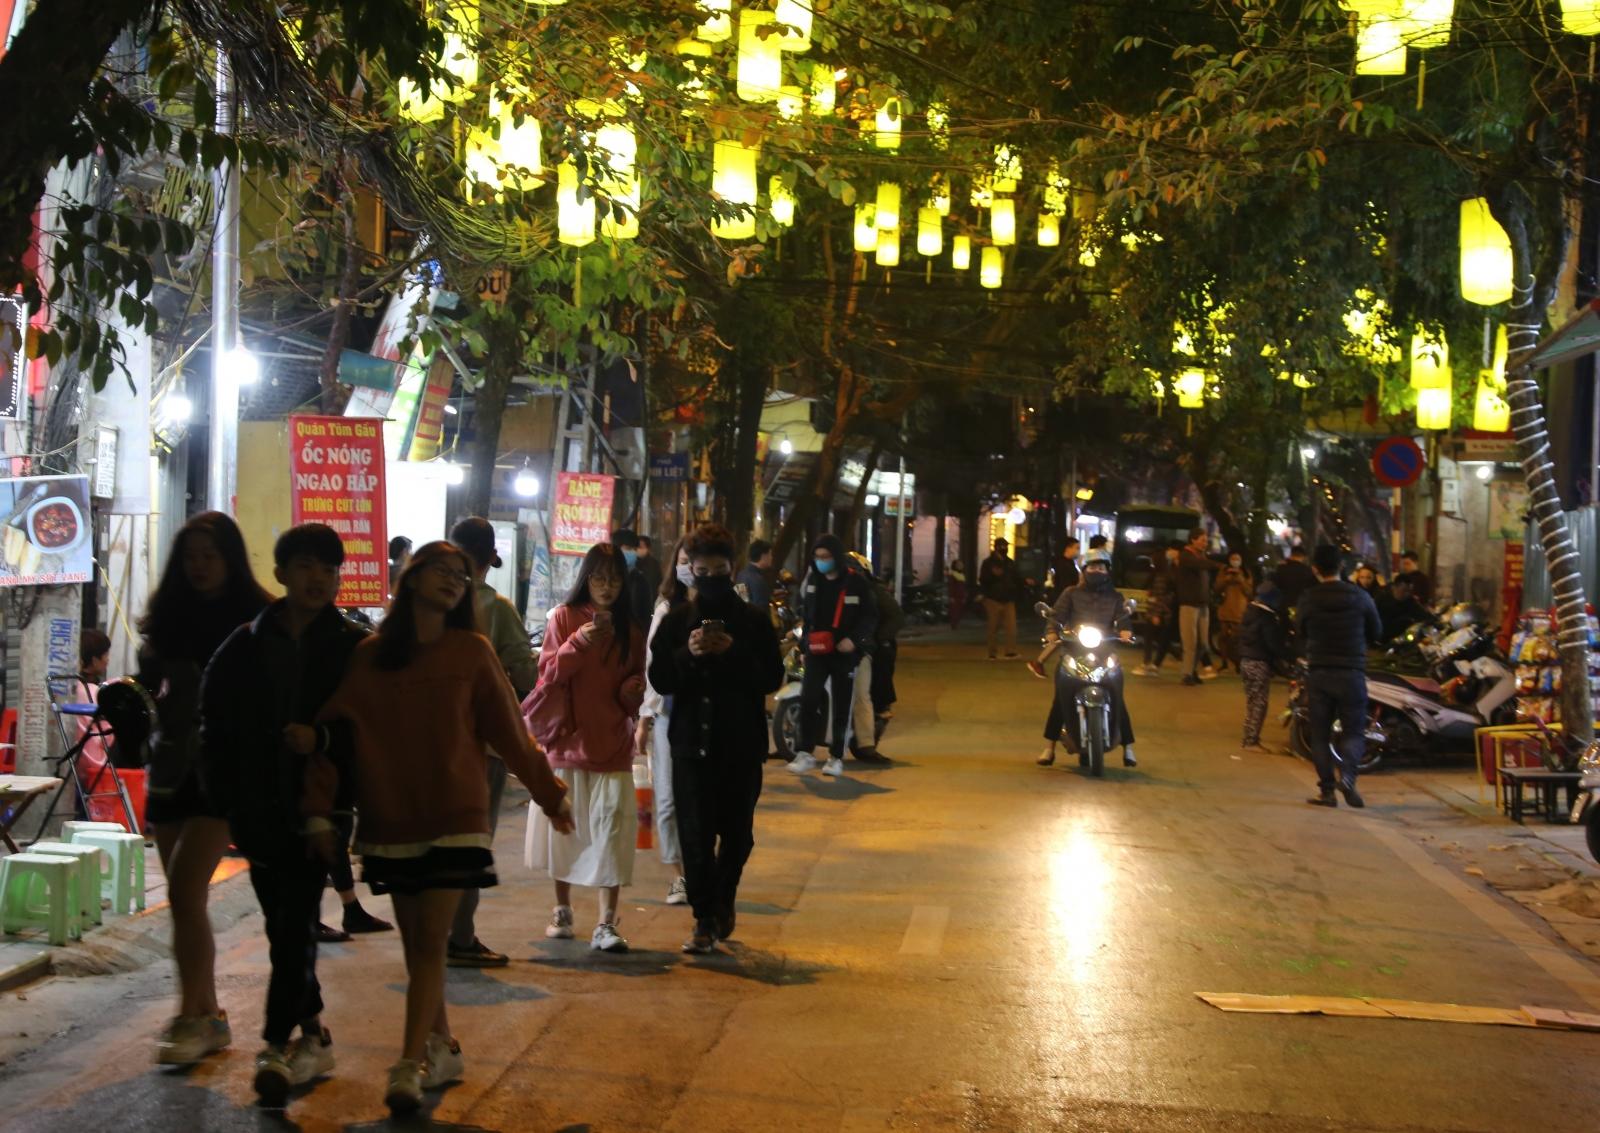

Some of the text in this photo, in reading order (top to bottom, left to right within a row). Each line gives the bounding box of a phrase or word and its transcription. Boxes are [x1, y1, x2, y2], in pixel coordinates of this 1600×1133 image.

[302, 440, 372, 465] ỐC NÓNG
[296, 467, 378, 491] NGAO HẤP
[360, 561, 380, 577] LOẠI
